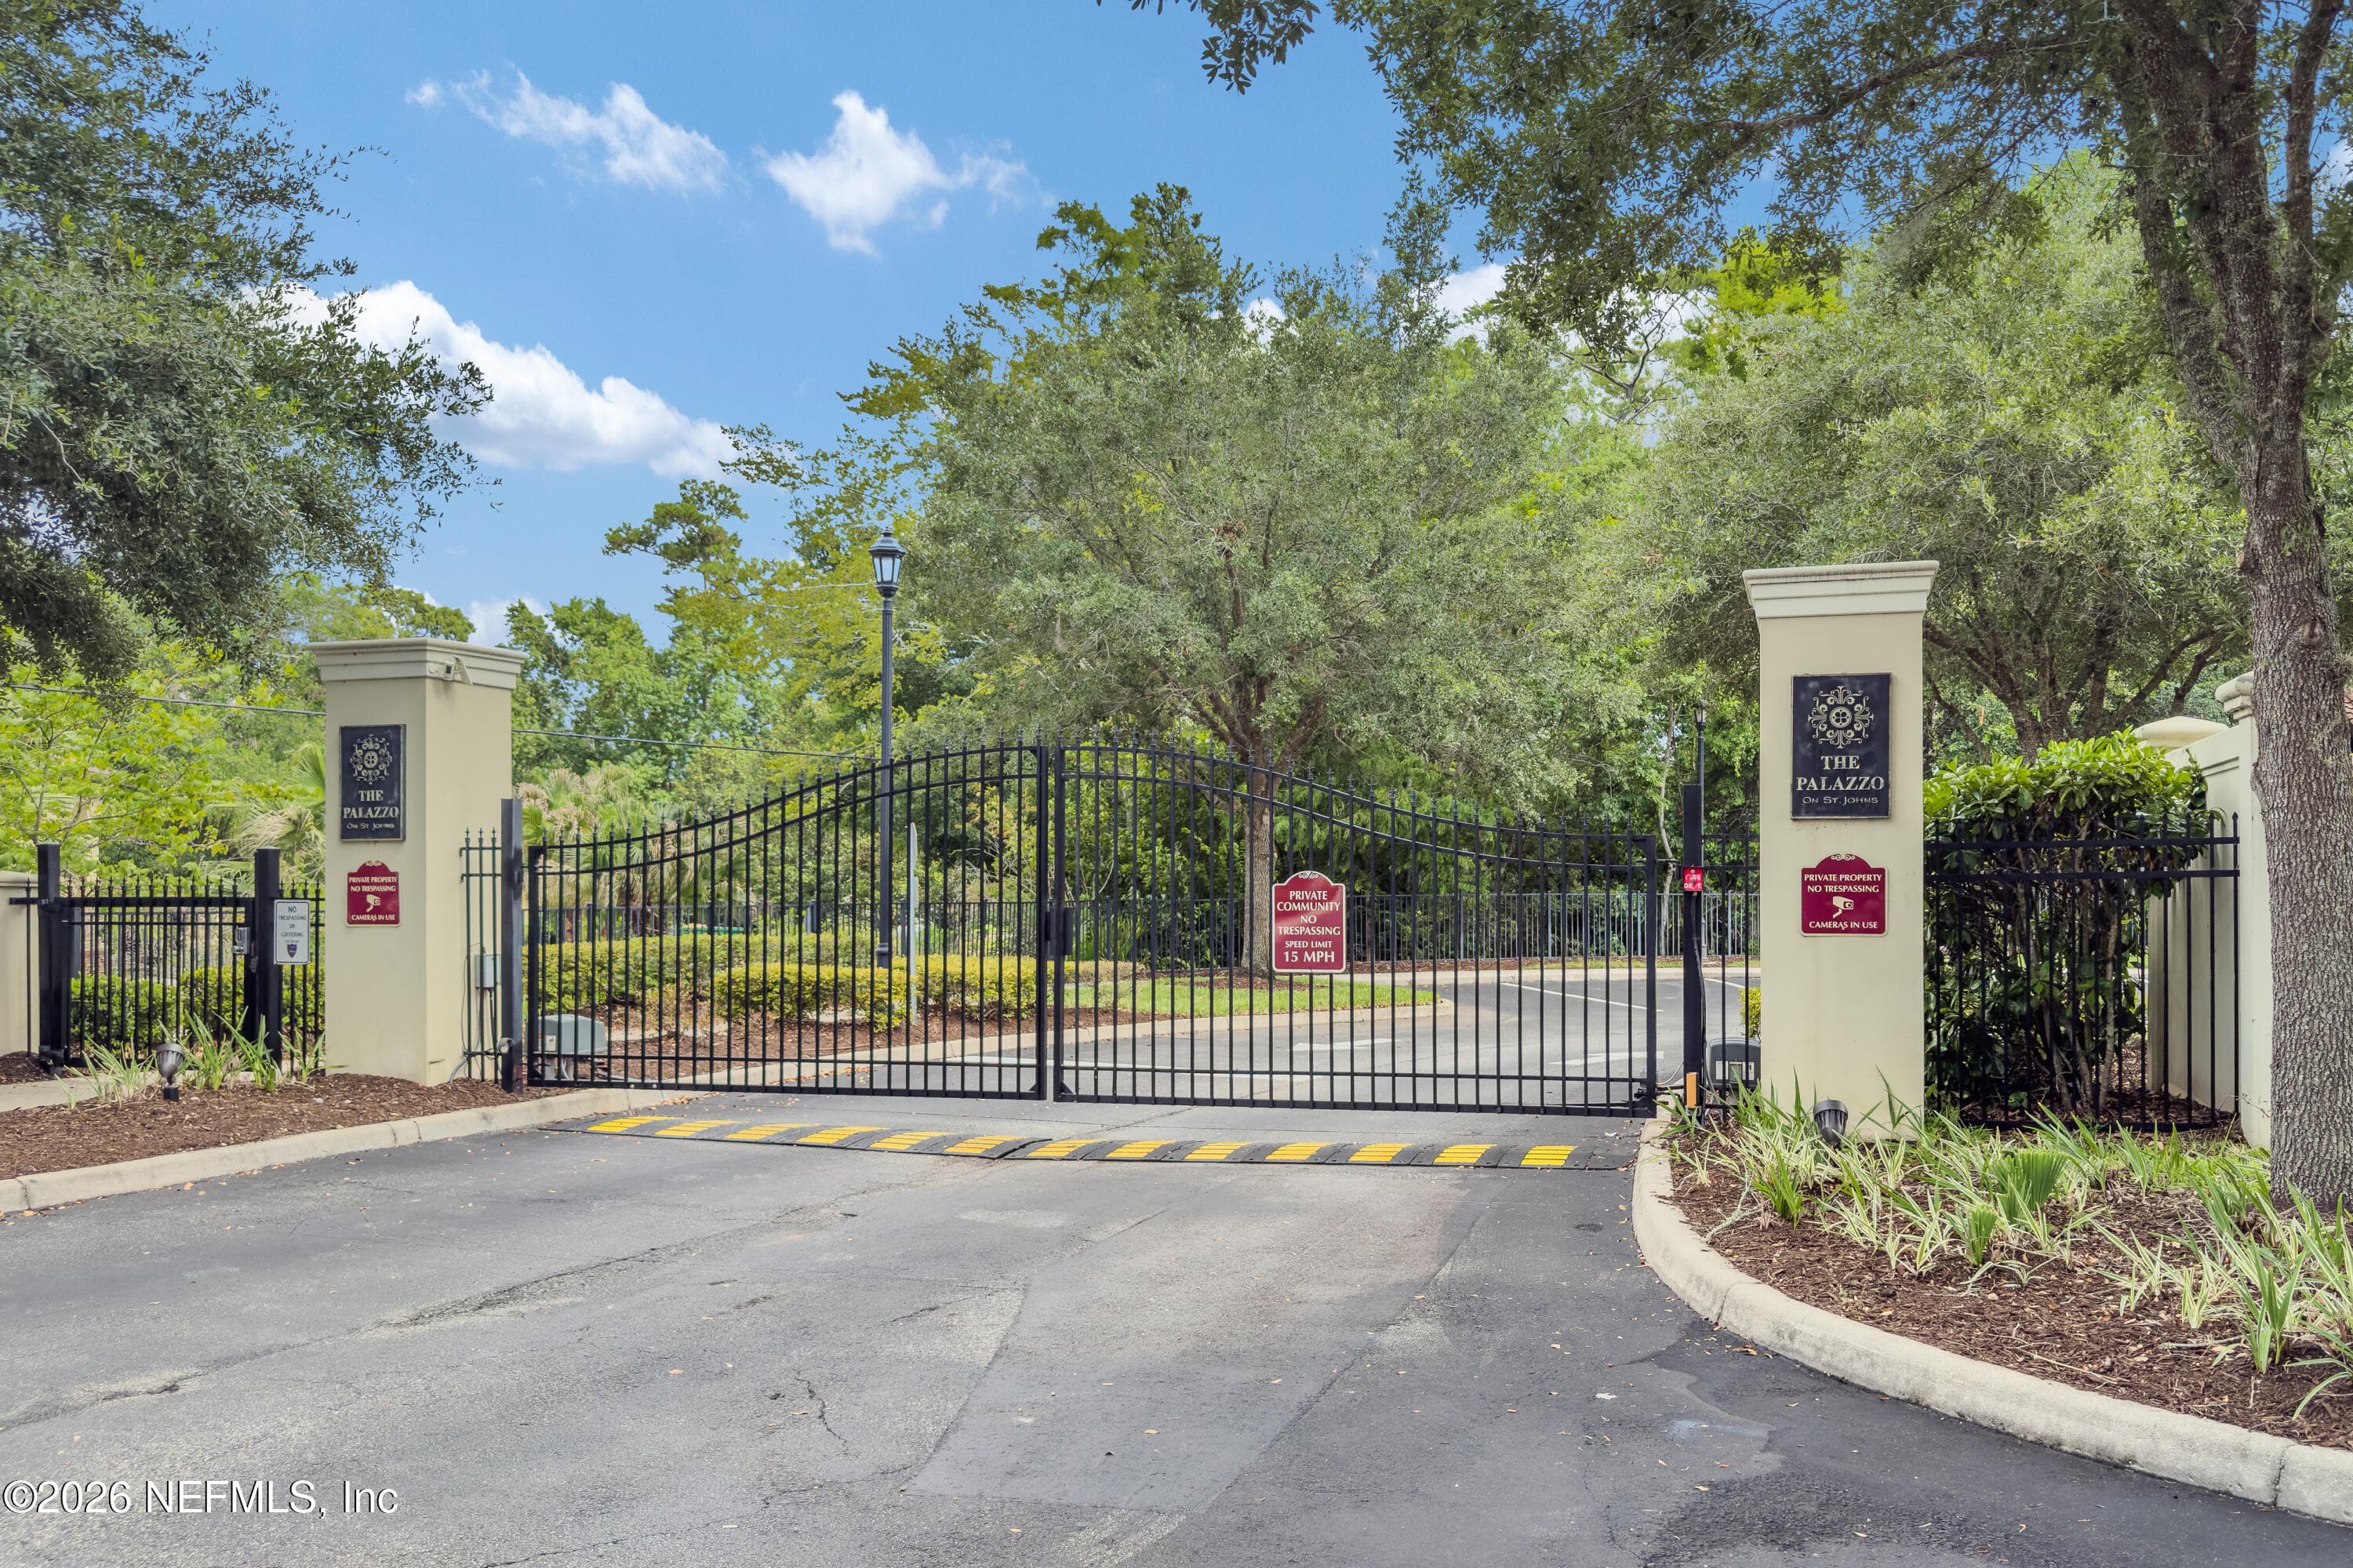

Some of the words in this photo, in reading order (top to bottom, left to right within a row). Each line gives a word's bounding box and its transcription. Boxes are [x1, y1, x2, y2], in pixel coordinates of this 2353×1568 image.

[1820, 755, 1860, 769] THE
[1795, 776, 1885, 791] PALAZZO
[358, 790, 384, 802] THE
[343, 806, 399, 819] PALAZZO
[1289, 890, 1328, 900] PRIVATE
[1277, 901, 1340, 911] COMMUNITY
[1300, 915, 1317, 924] NO
[1278, 926, 1340, 935] TRESPASSING
[1283, 951, 1299, 962] 15
[1303, 951, 1335, 962] MPH
